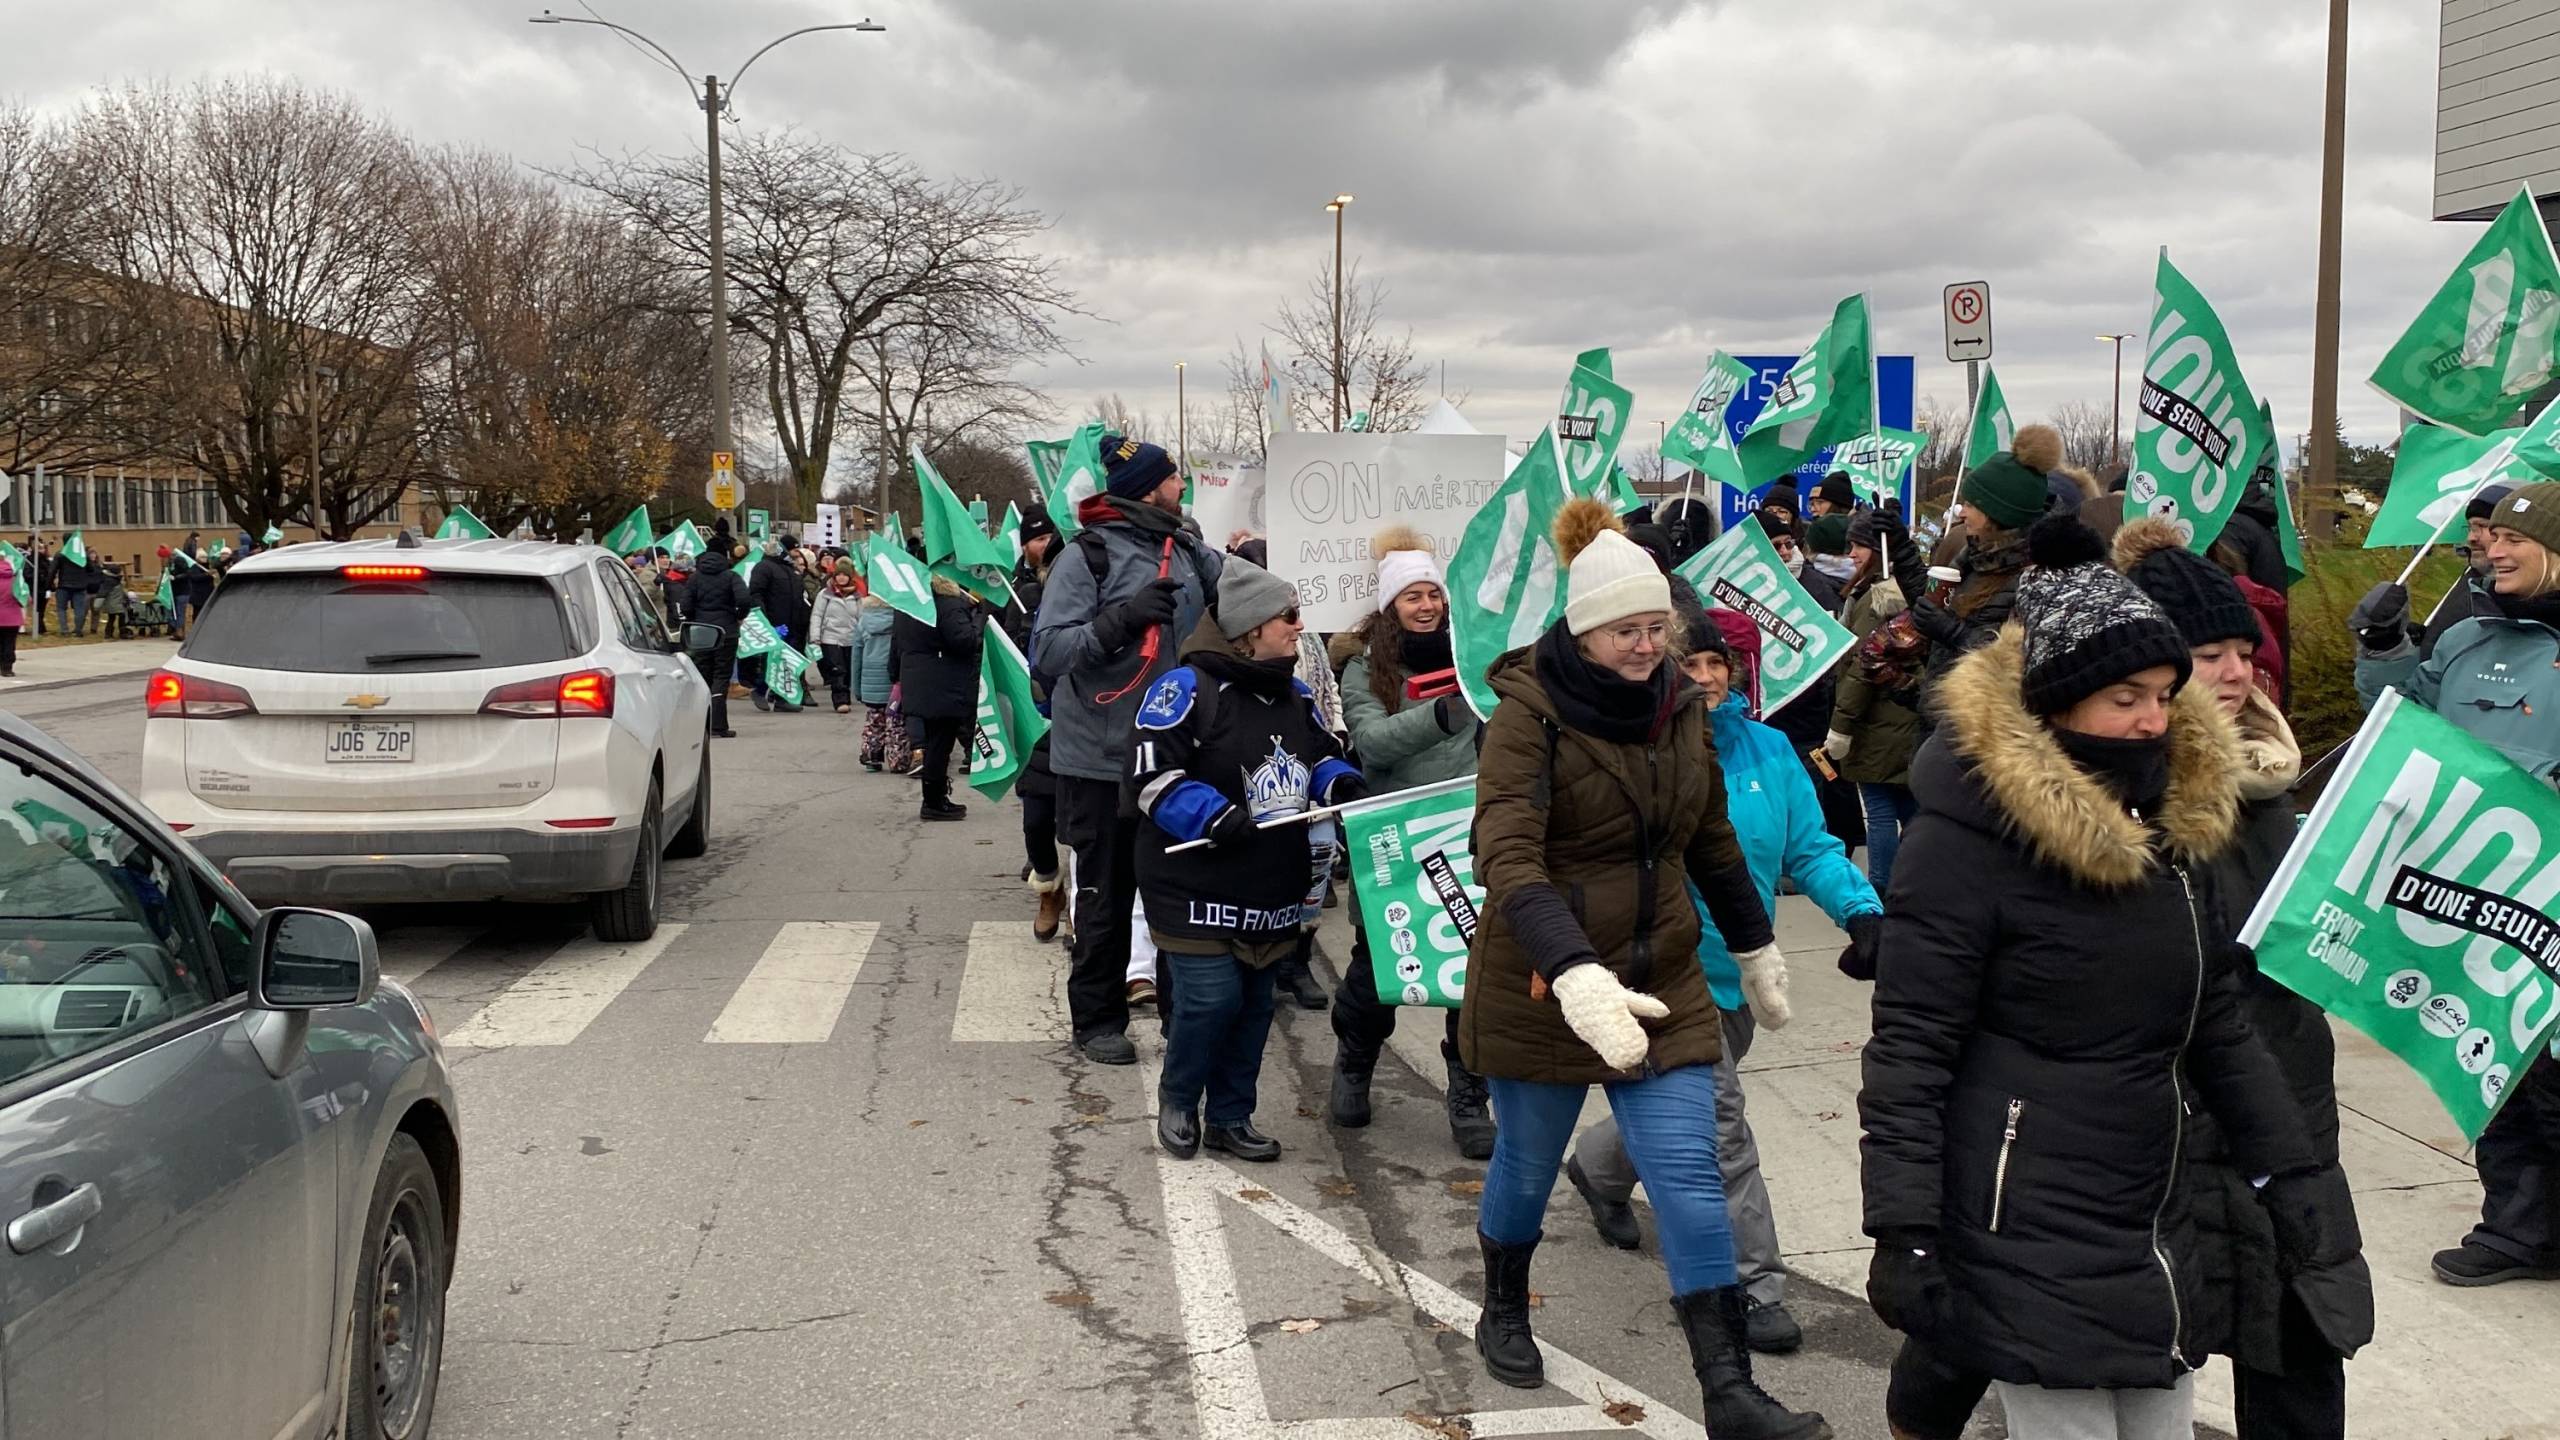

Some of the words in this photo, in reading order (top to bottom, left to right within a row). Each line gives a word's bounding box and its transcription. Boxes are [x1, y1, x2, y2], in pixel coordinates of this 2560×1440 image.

[1571, 420, 1595, 437] VOIX
[2169, 402, 2207, 441] SEULE
[2204, 428, 2227, 462] VOIX
[1290, 460, 1381, 524] ON
[1338, 572, 1380, 603] PEA
[1682, 525, 1829, 681] NOUS
[1714, 582, 1750, 611] D'UNE
[1745, 602, 1780, 630] SEULE
[1776, 623, 1805, 649] VOIX
[376, 732, 411, 752] ZDP
[975, 731, 992, 756] VOIX
[1134, 741, 1157, 777] 11
[1368, 833, 1393, 887] COMMUN
[1382, 823, 1404, 862] FRONT
[1426, 856, 1454, 900] D'UNE
[1188, 901, 1238, 927] LOS
[1242, 903, 1301, 931] ANGEL
[2310, 899, 2366, 947] FRONT
[2396, 875, 2475, 922] D'UNE
[2475, 900, 2550, 952] SEULE
[2306, 931, 2370, 986] COMMUN
[2389, 989, 2409, 1004] CSN
[2445, 1008, 2467, 1027] CSQ
